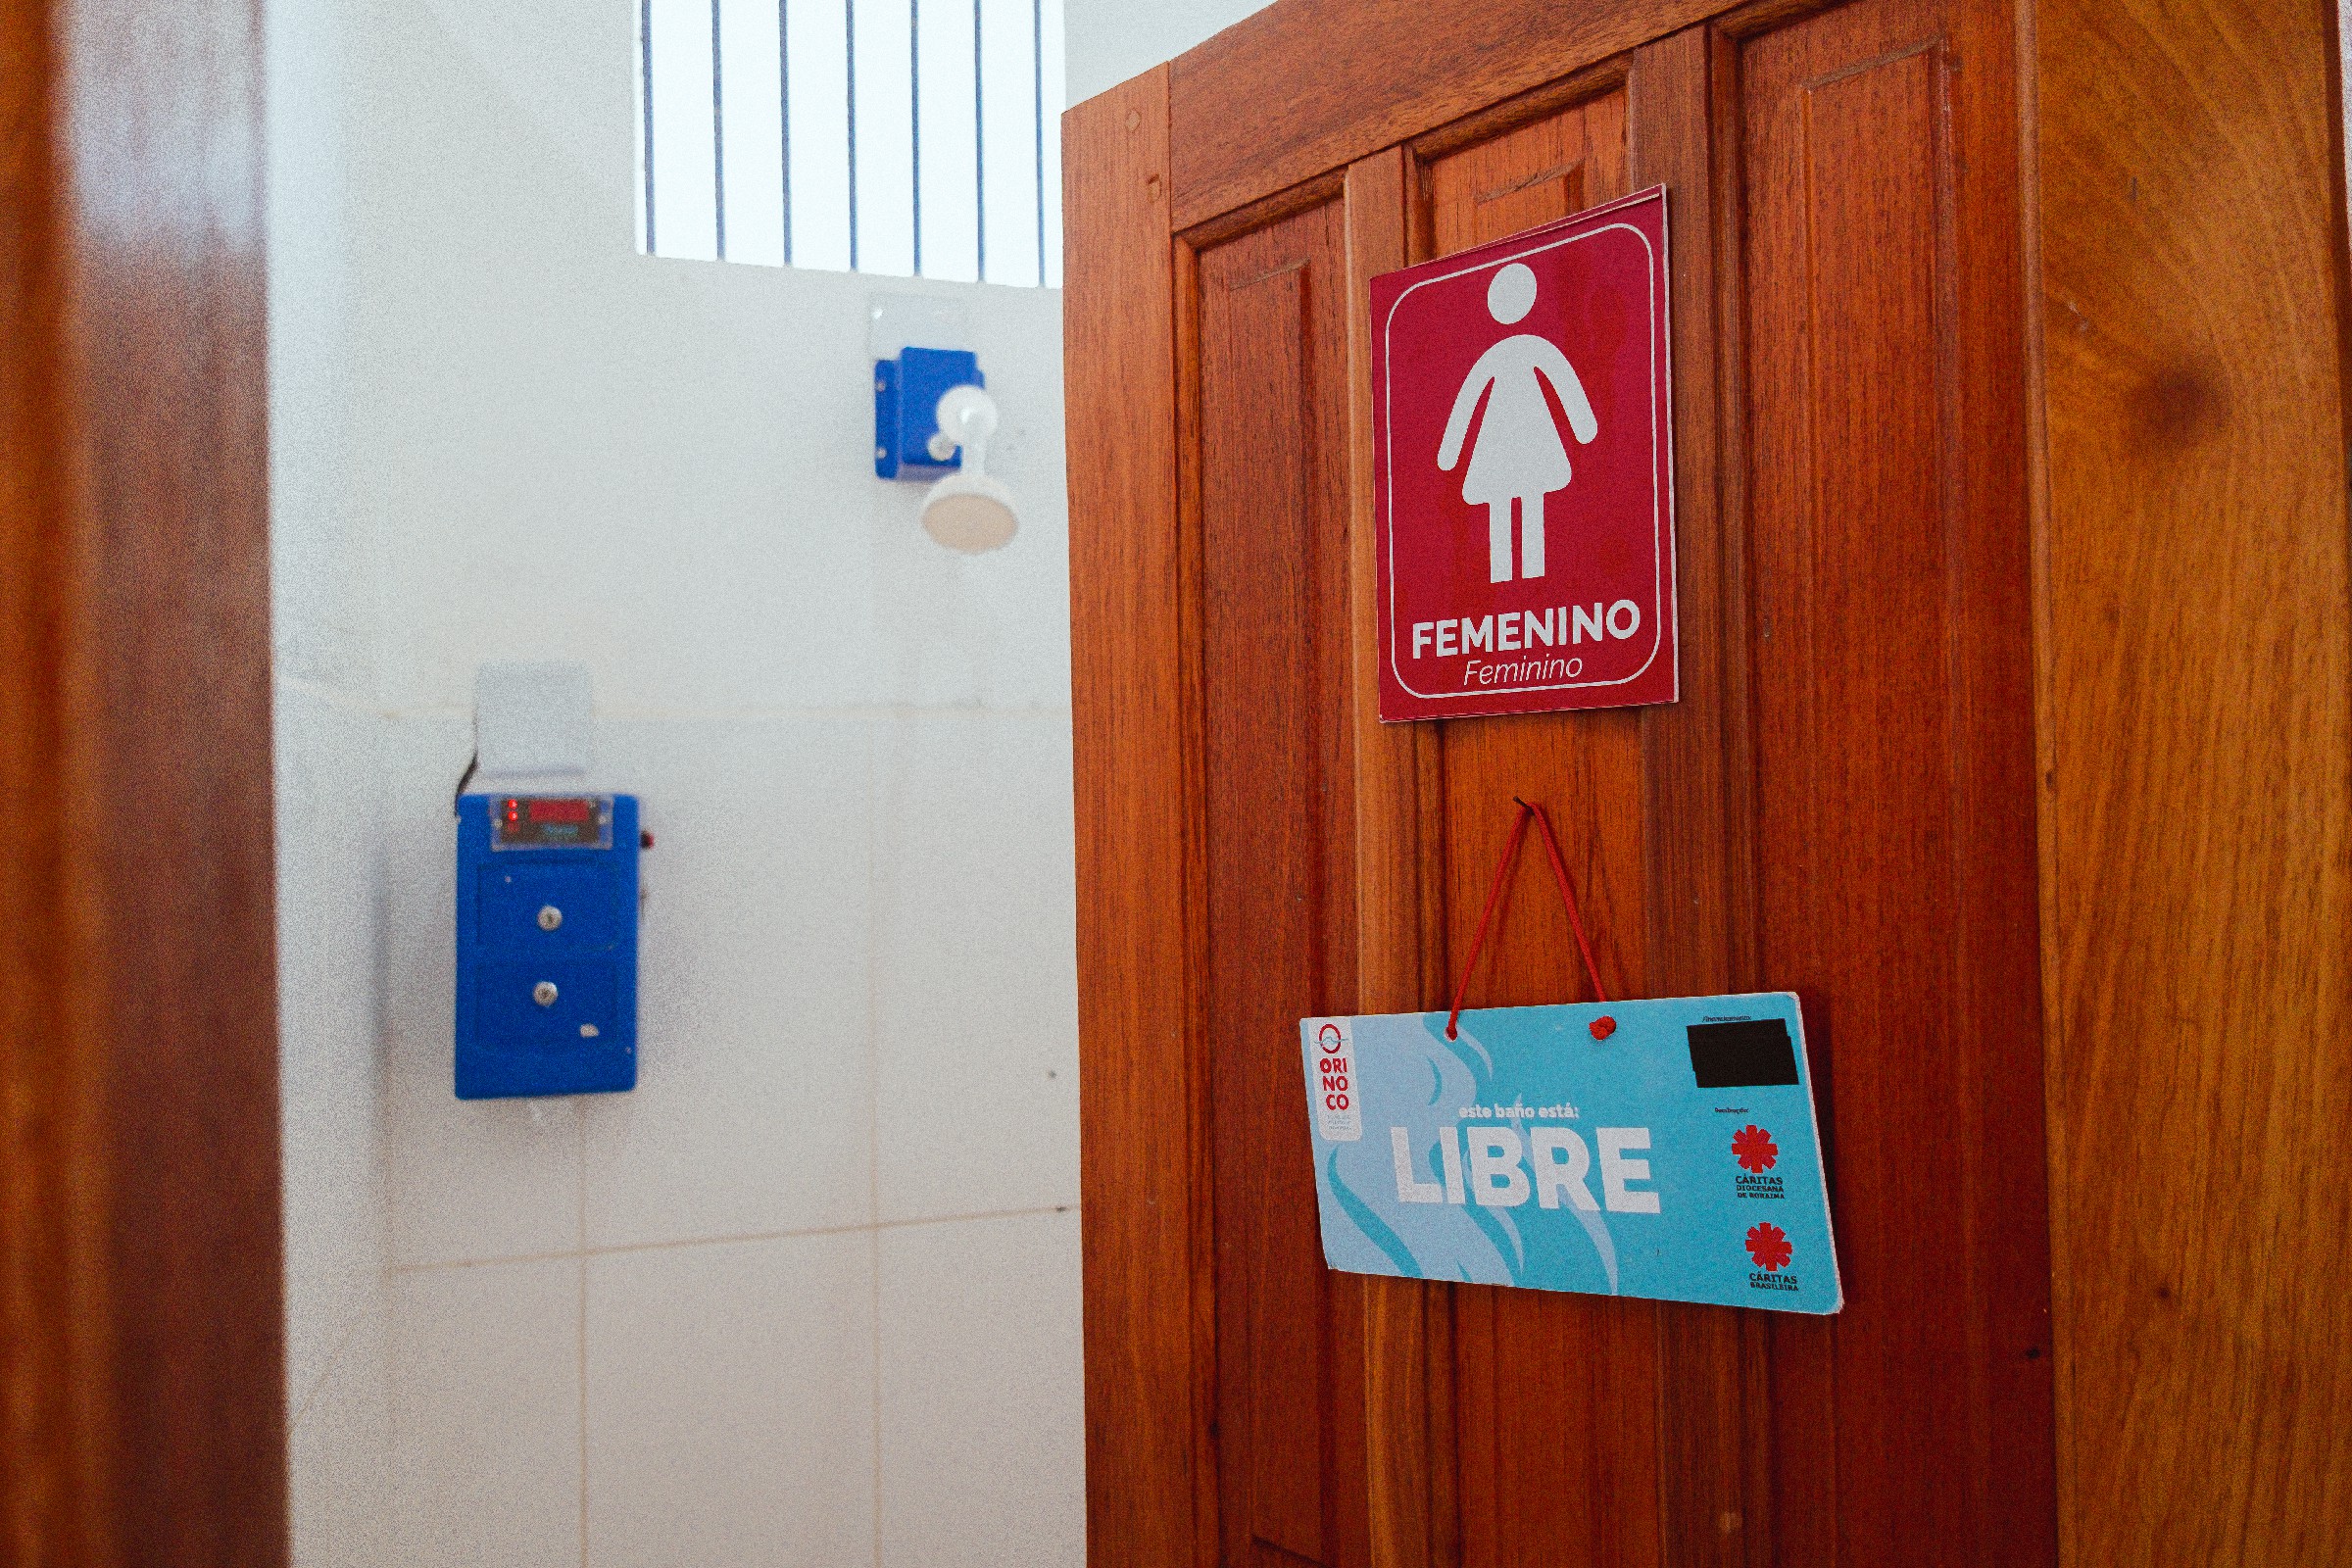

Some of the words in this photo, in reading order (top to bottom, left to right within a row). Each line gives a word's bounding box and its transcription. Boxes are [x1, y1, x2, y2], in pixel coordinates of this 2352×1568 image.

[1412, 599, 1641, 660] FEMENINO
[1463, 653, 1584, 686] Feminino
[1319, 1057, 1348, 1074] ORI
[1322, 1075, 1348, 1092] NO
[1325, 1093, 1349, 1110] CO
[1458, 1104, 1492, 1119] este
[1494, 1102, 1536, 1119] baño
[1538, 1102, 1580, 1119] está:
[1390, 1126, 1661, 1214] LIBRE
[1735, 1173, 1784, 1186] CÁRITAS
[1736, 1184, 1785, 1194] DIOCESANA
[1748, 1271, 1798, 1285] CÁRITAS
